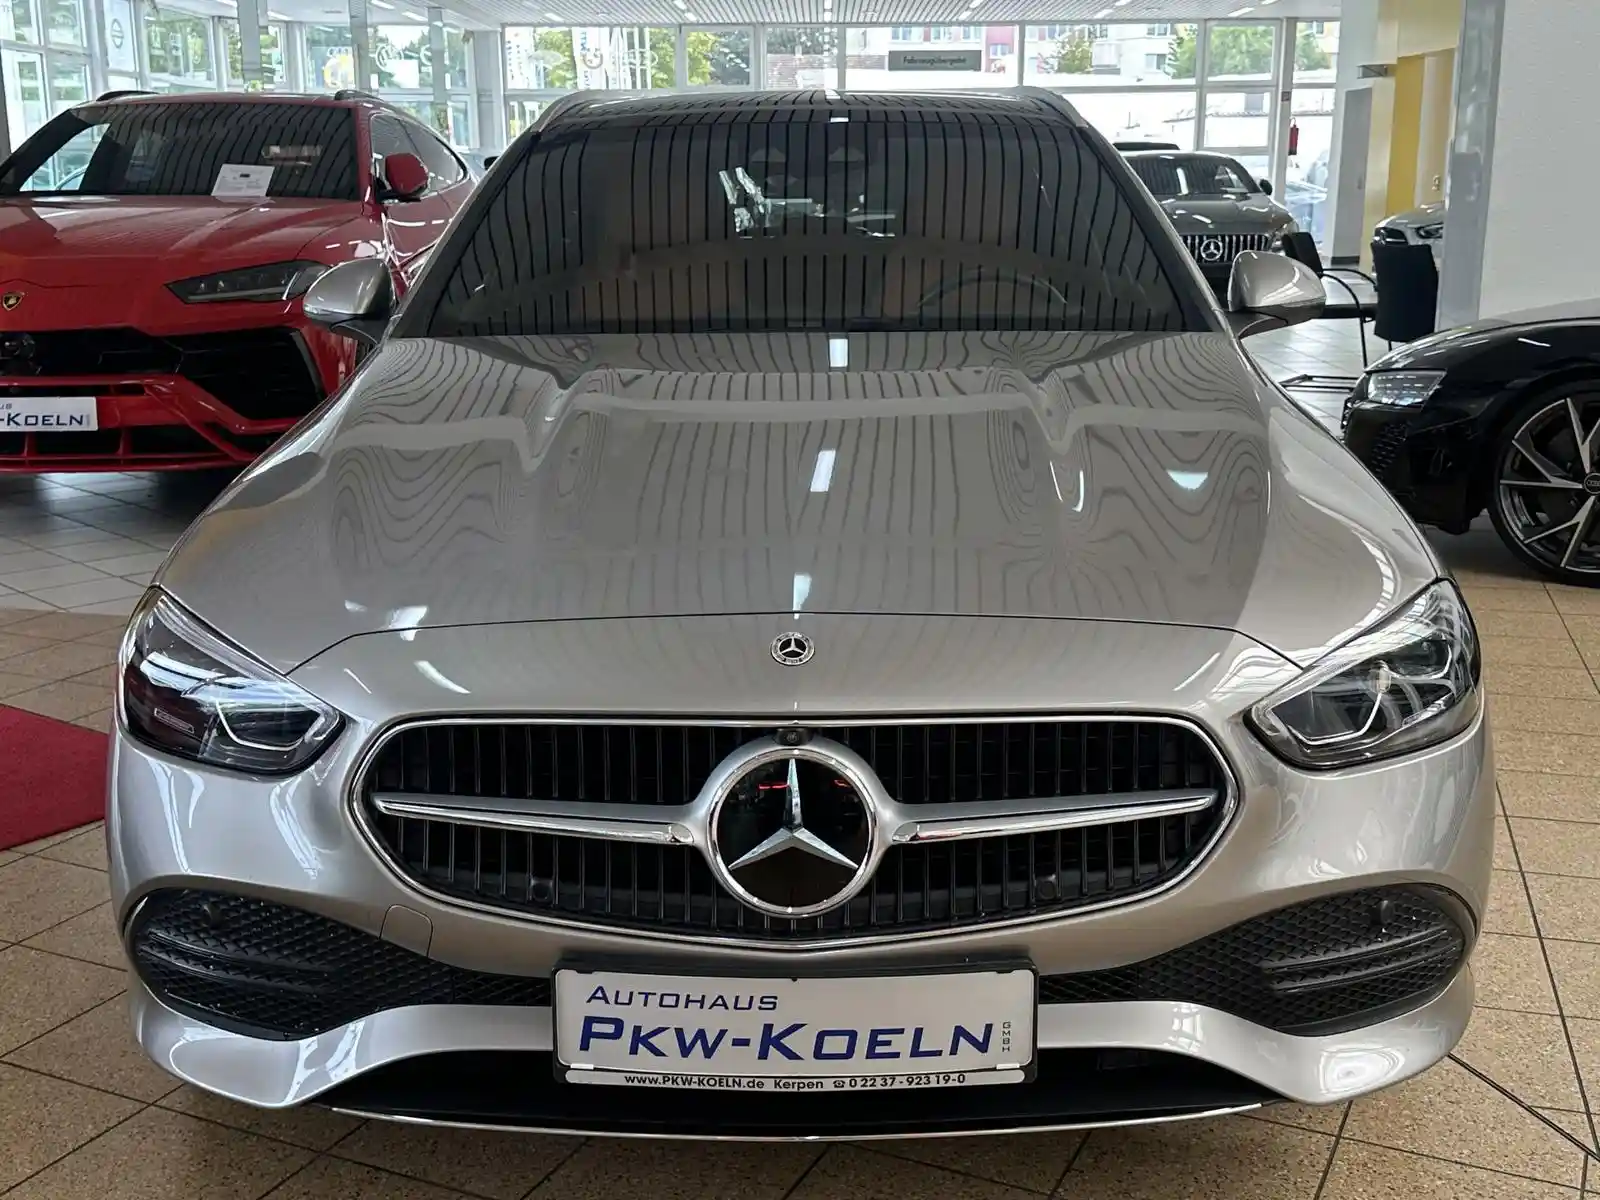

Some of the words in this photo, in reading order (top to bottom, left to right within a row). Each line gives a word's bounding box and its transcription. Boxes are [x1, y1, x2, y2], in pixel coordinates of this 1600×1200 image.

[586, 985, 778, 1011] AUTOHAUS
[579, 1015, 994, 1061] PKW-KOELN
[624, 1075, 765, 1089] www.PKW-KOELN.de
[774, 1079, 824, 1091] Kerpen
